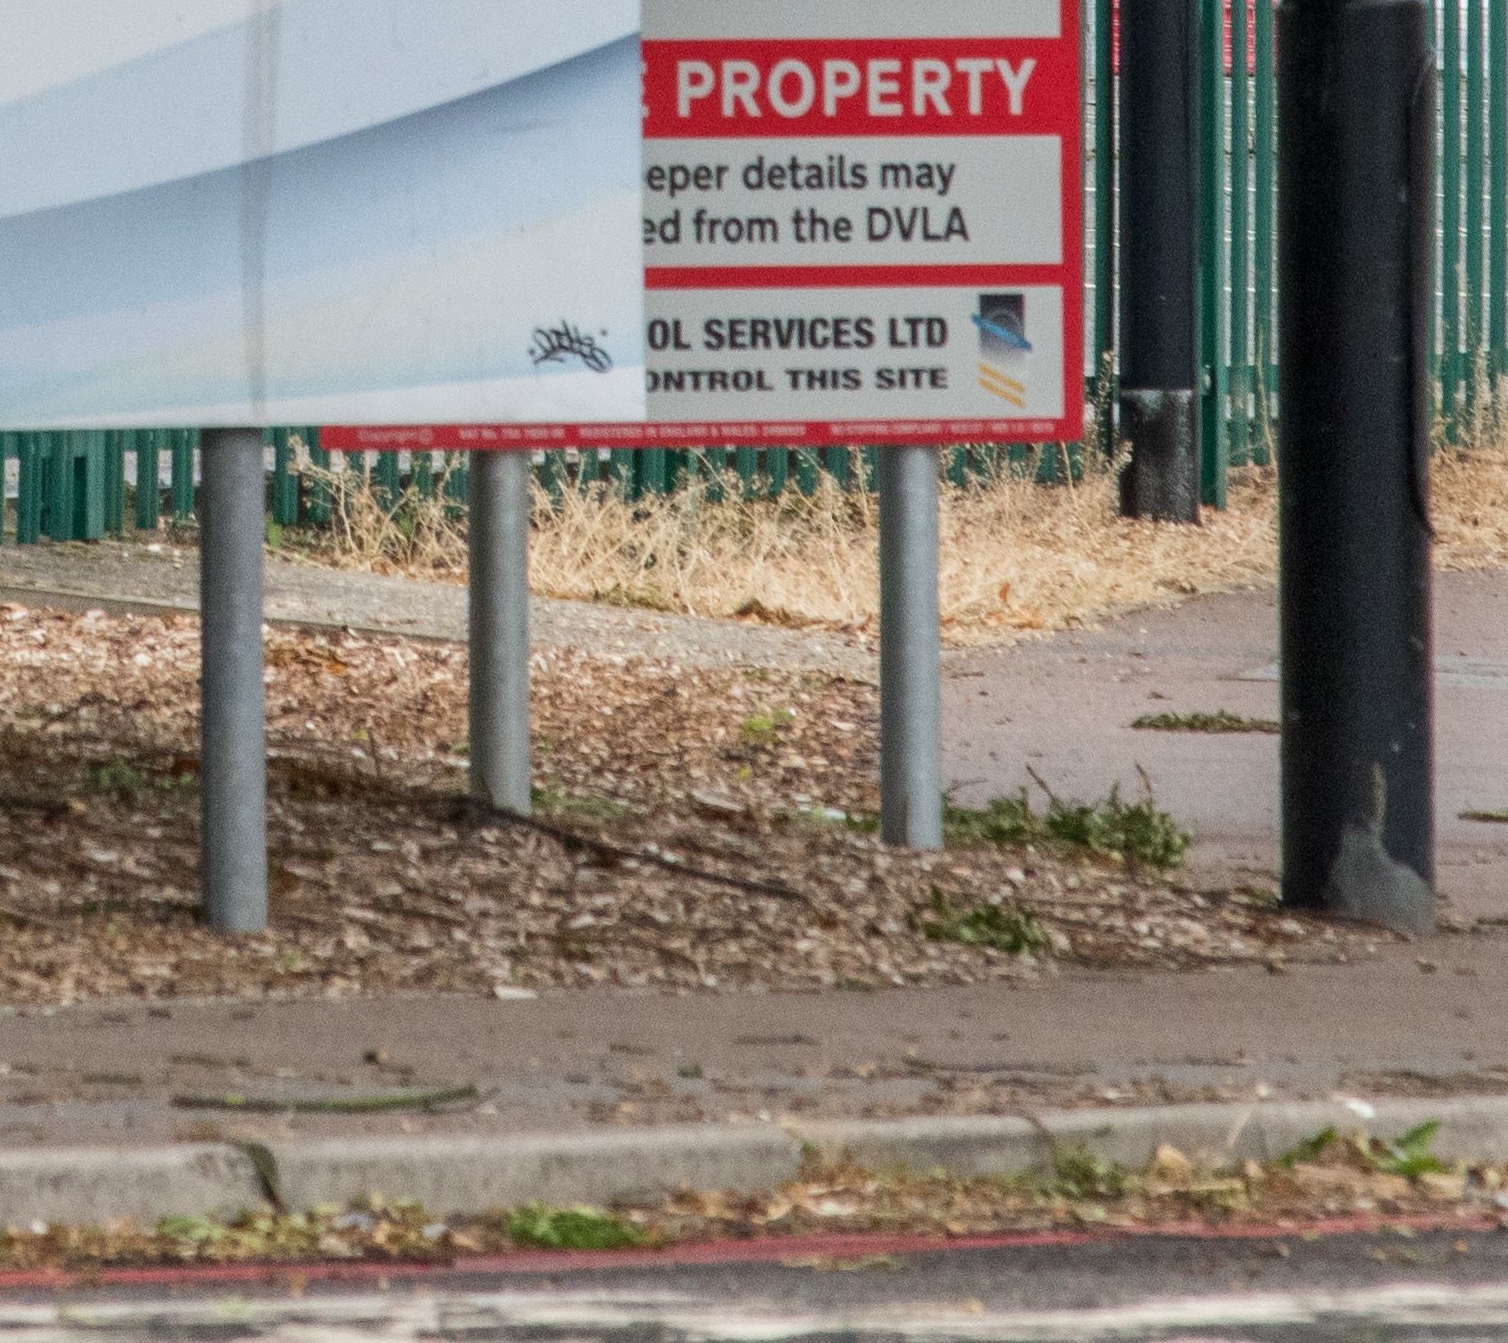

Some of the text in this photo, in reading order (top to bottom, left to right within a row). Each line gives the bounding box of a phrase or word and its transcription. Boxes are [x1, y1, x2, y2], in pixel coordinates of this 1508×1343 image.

[677, 58, 1037, 118] PROPERTY
[741, 154, 868, 191] details
[880, 162, 956, 196] may
[692, 208, 779, 244] from
[791, 207, 853, 244] the
[866, 206, 969, 243] DVLA
[703, 317, 875, 351] SERVICES
[888, 316, 948, 348] LTD
[785, 368, 862, 390] THIS
[875, 367, 947, 390] SITE
